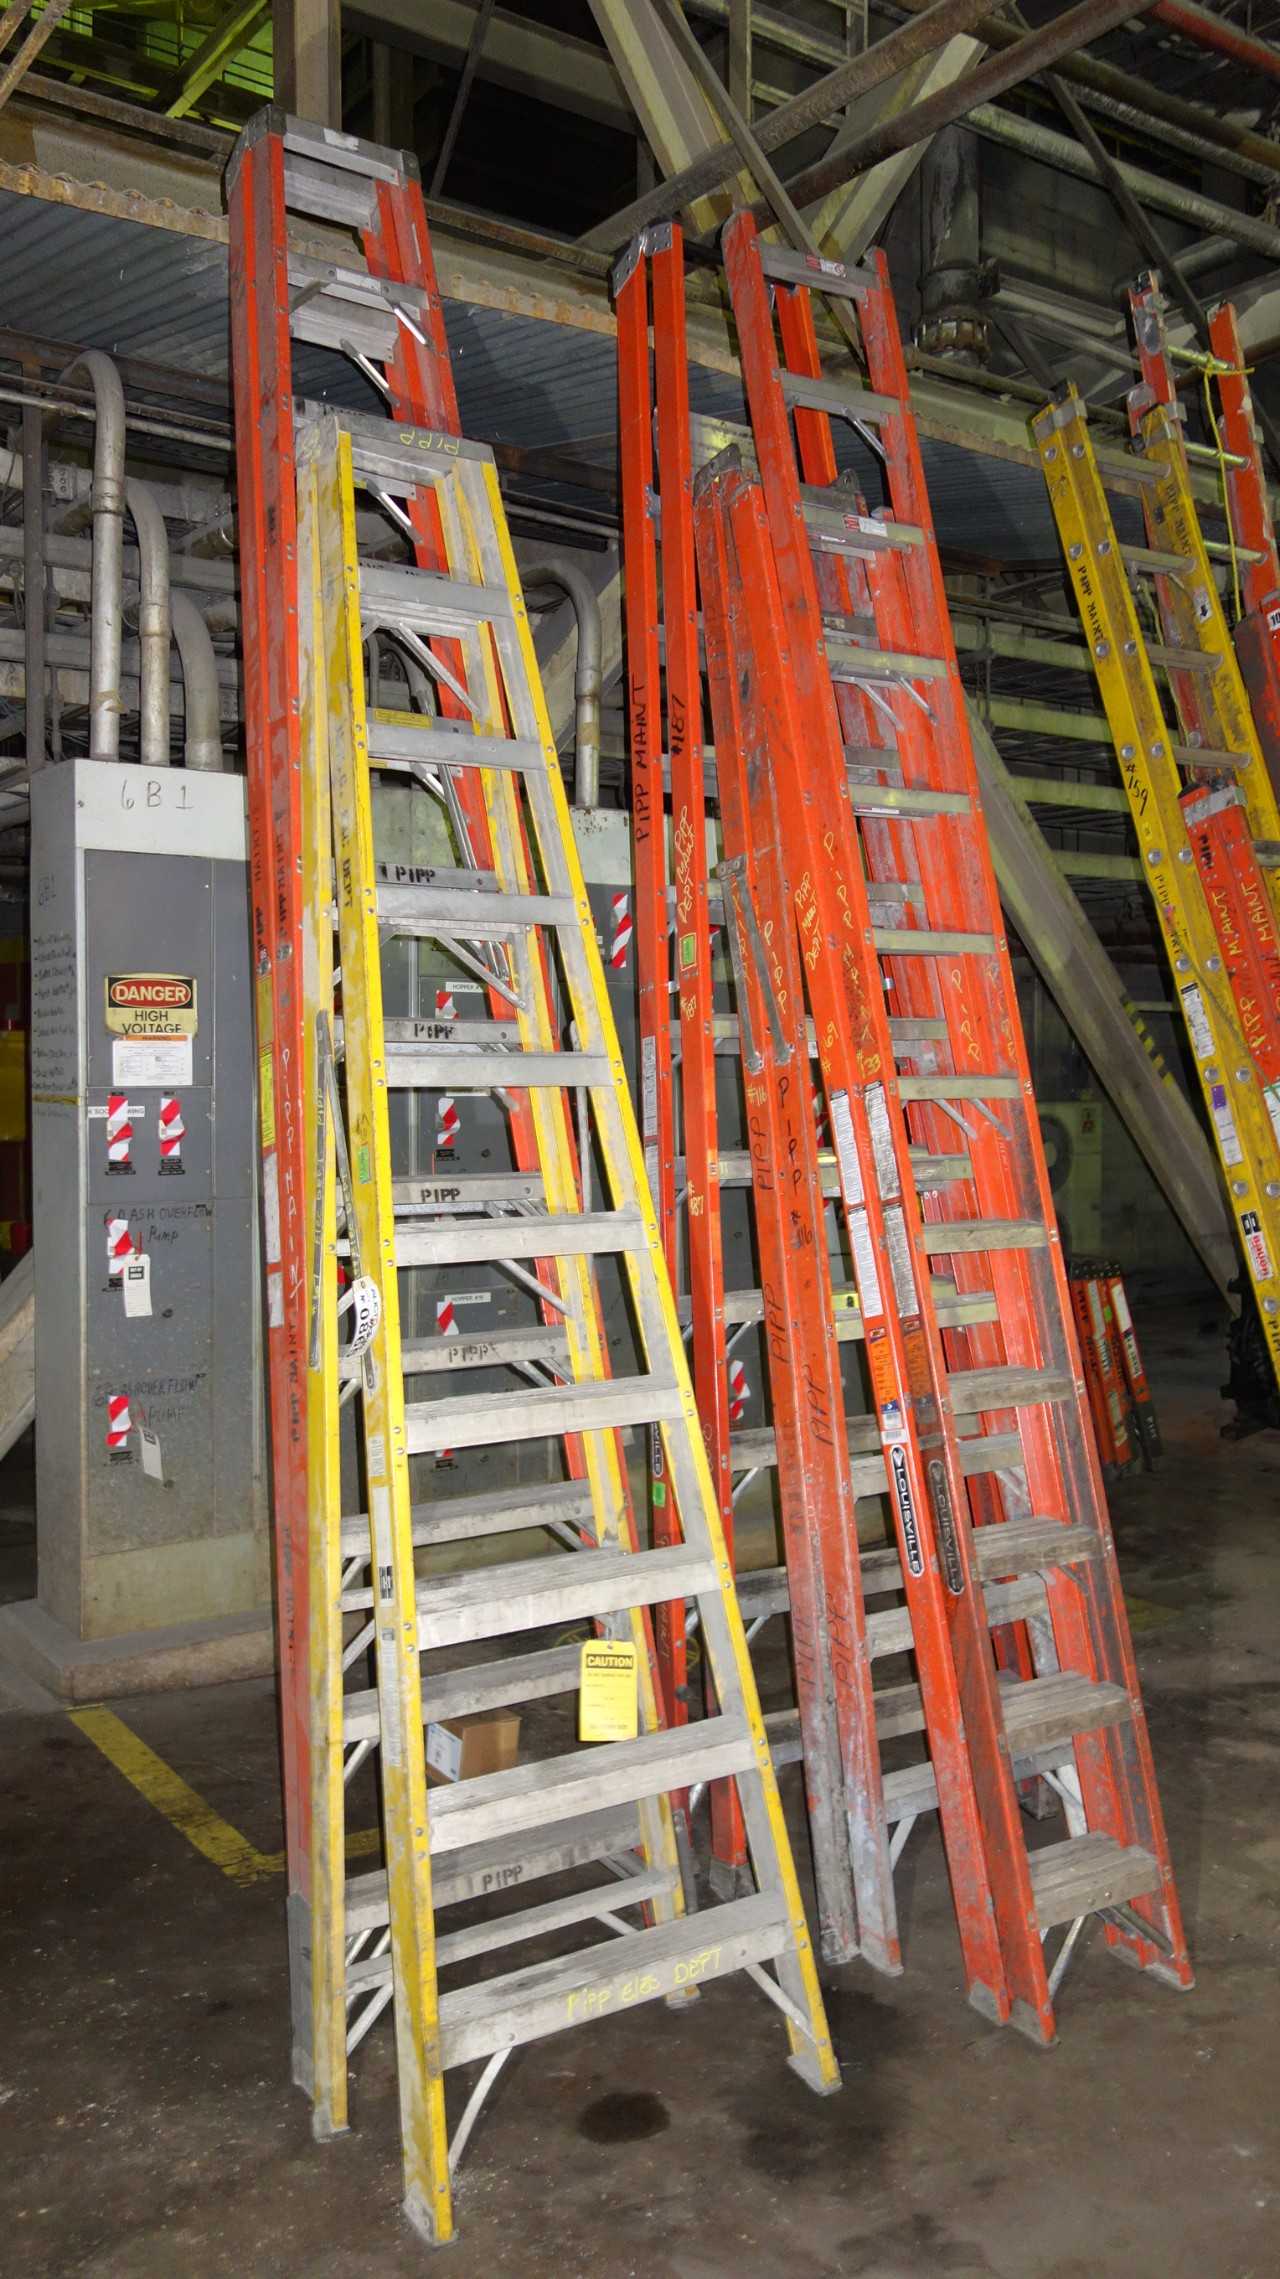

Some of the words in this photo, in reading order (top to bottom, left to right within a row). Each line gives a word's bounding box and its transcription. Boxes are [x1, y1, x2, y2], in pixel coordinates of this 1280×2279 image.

[632, 671, 648, 769] MAINT
[634, 783, 650, 845] PIPP
[115, 985, 187, 1002] DANGER
[134, 1010, 169, 1022] HIGH
[121, 1023, 182, 1035] VOLTAGE
[421, 1187, 461, 1203] PIPP
[896, 1467, 922, 1574] LOUISVILLE
[935, 1482, 962, 1590] LOUISVILLE
[587, 1655, 633, 1668] CAUTION
[482, 1864, 524, 1893] PIPP
